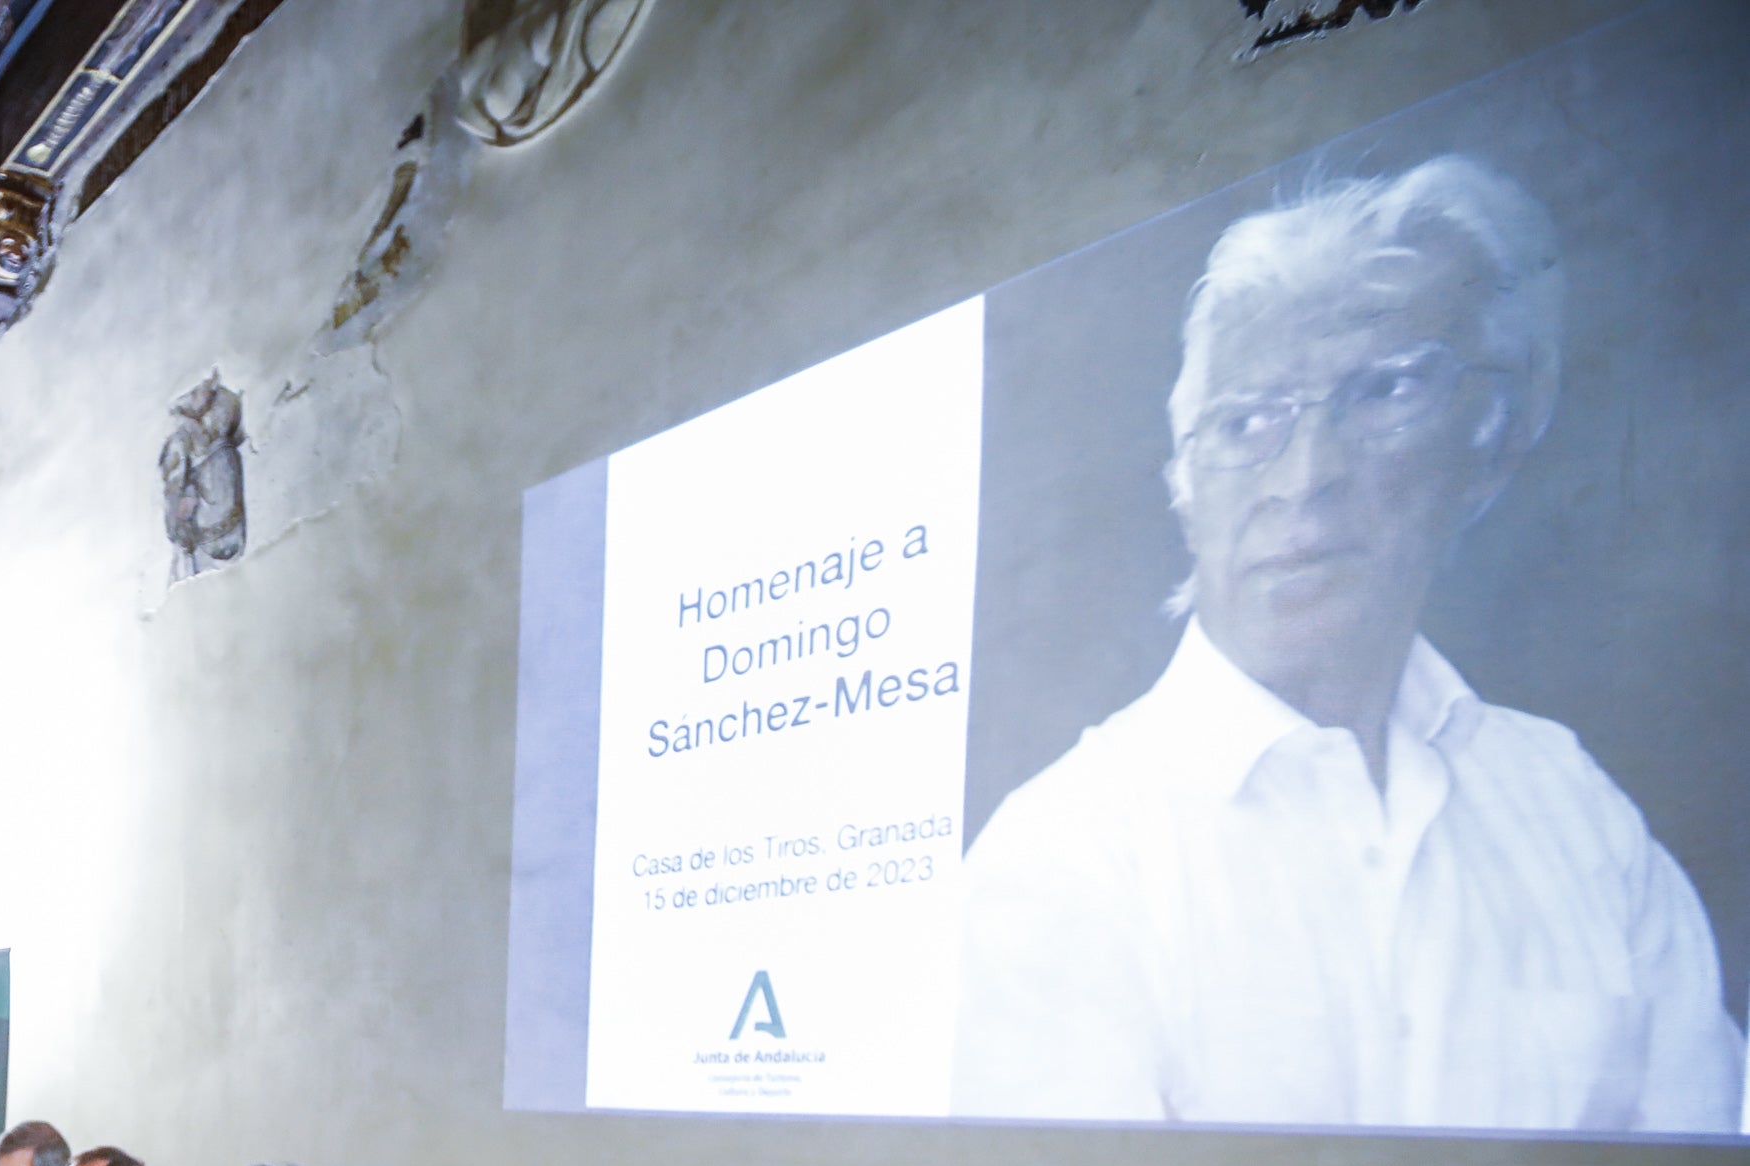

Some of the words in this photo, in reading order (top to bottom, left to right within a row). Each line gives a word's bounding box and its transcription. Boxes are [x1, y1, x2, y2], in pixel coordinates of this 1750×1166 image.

[678, 537, 885, 627] Homenaje
[901, 524, 930, 558] a
[703, 607, 892, 683] Domingo
[648, 661, 961, 757] Sánchez-Mesa
[632, 850, 683, 877] Casa
[690, 847, 716, 871] de
[723, 844, 755, 866] los
[836, 813, 954, 851] Granada
[643, 888, 666, 911] 15
[672, 886, 699, 909] de
[703, 871, 819, 907] diciembre
[825, 866, 858, 893] de
[865, 855, 936, 888] 2023
[693, 1050, 731, 1065] Junta
[734, 1050, 750, 1064] de
